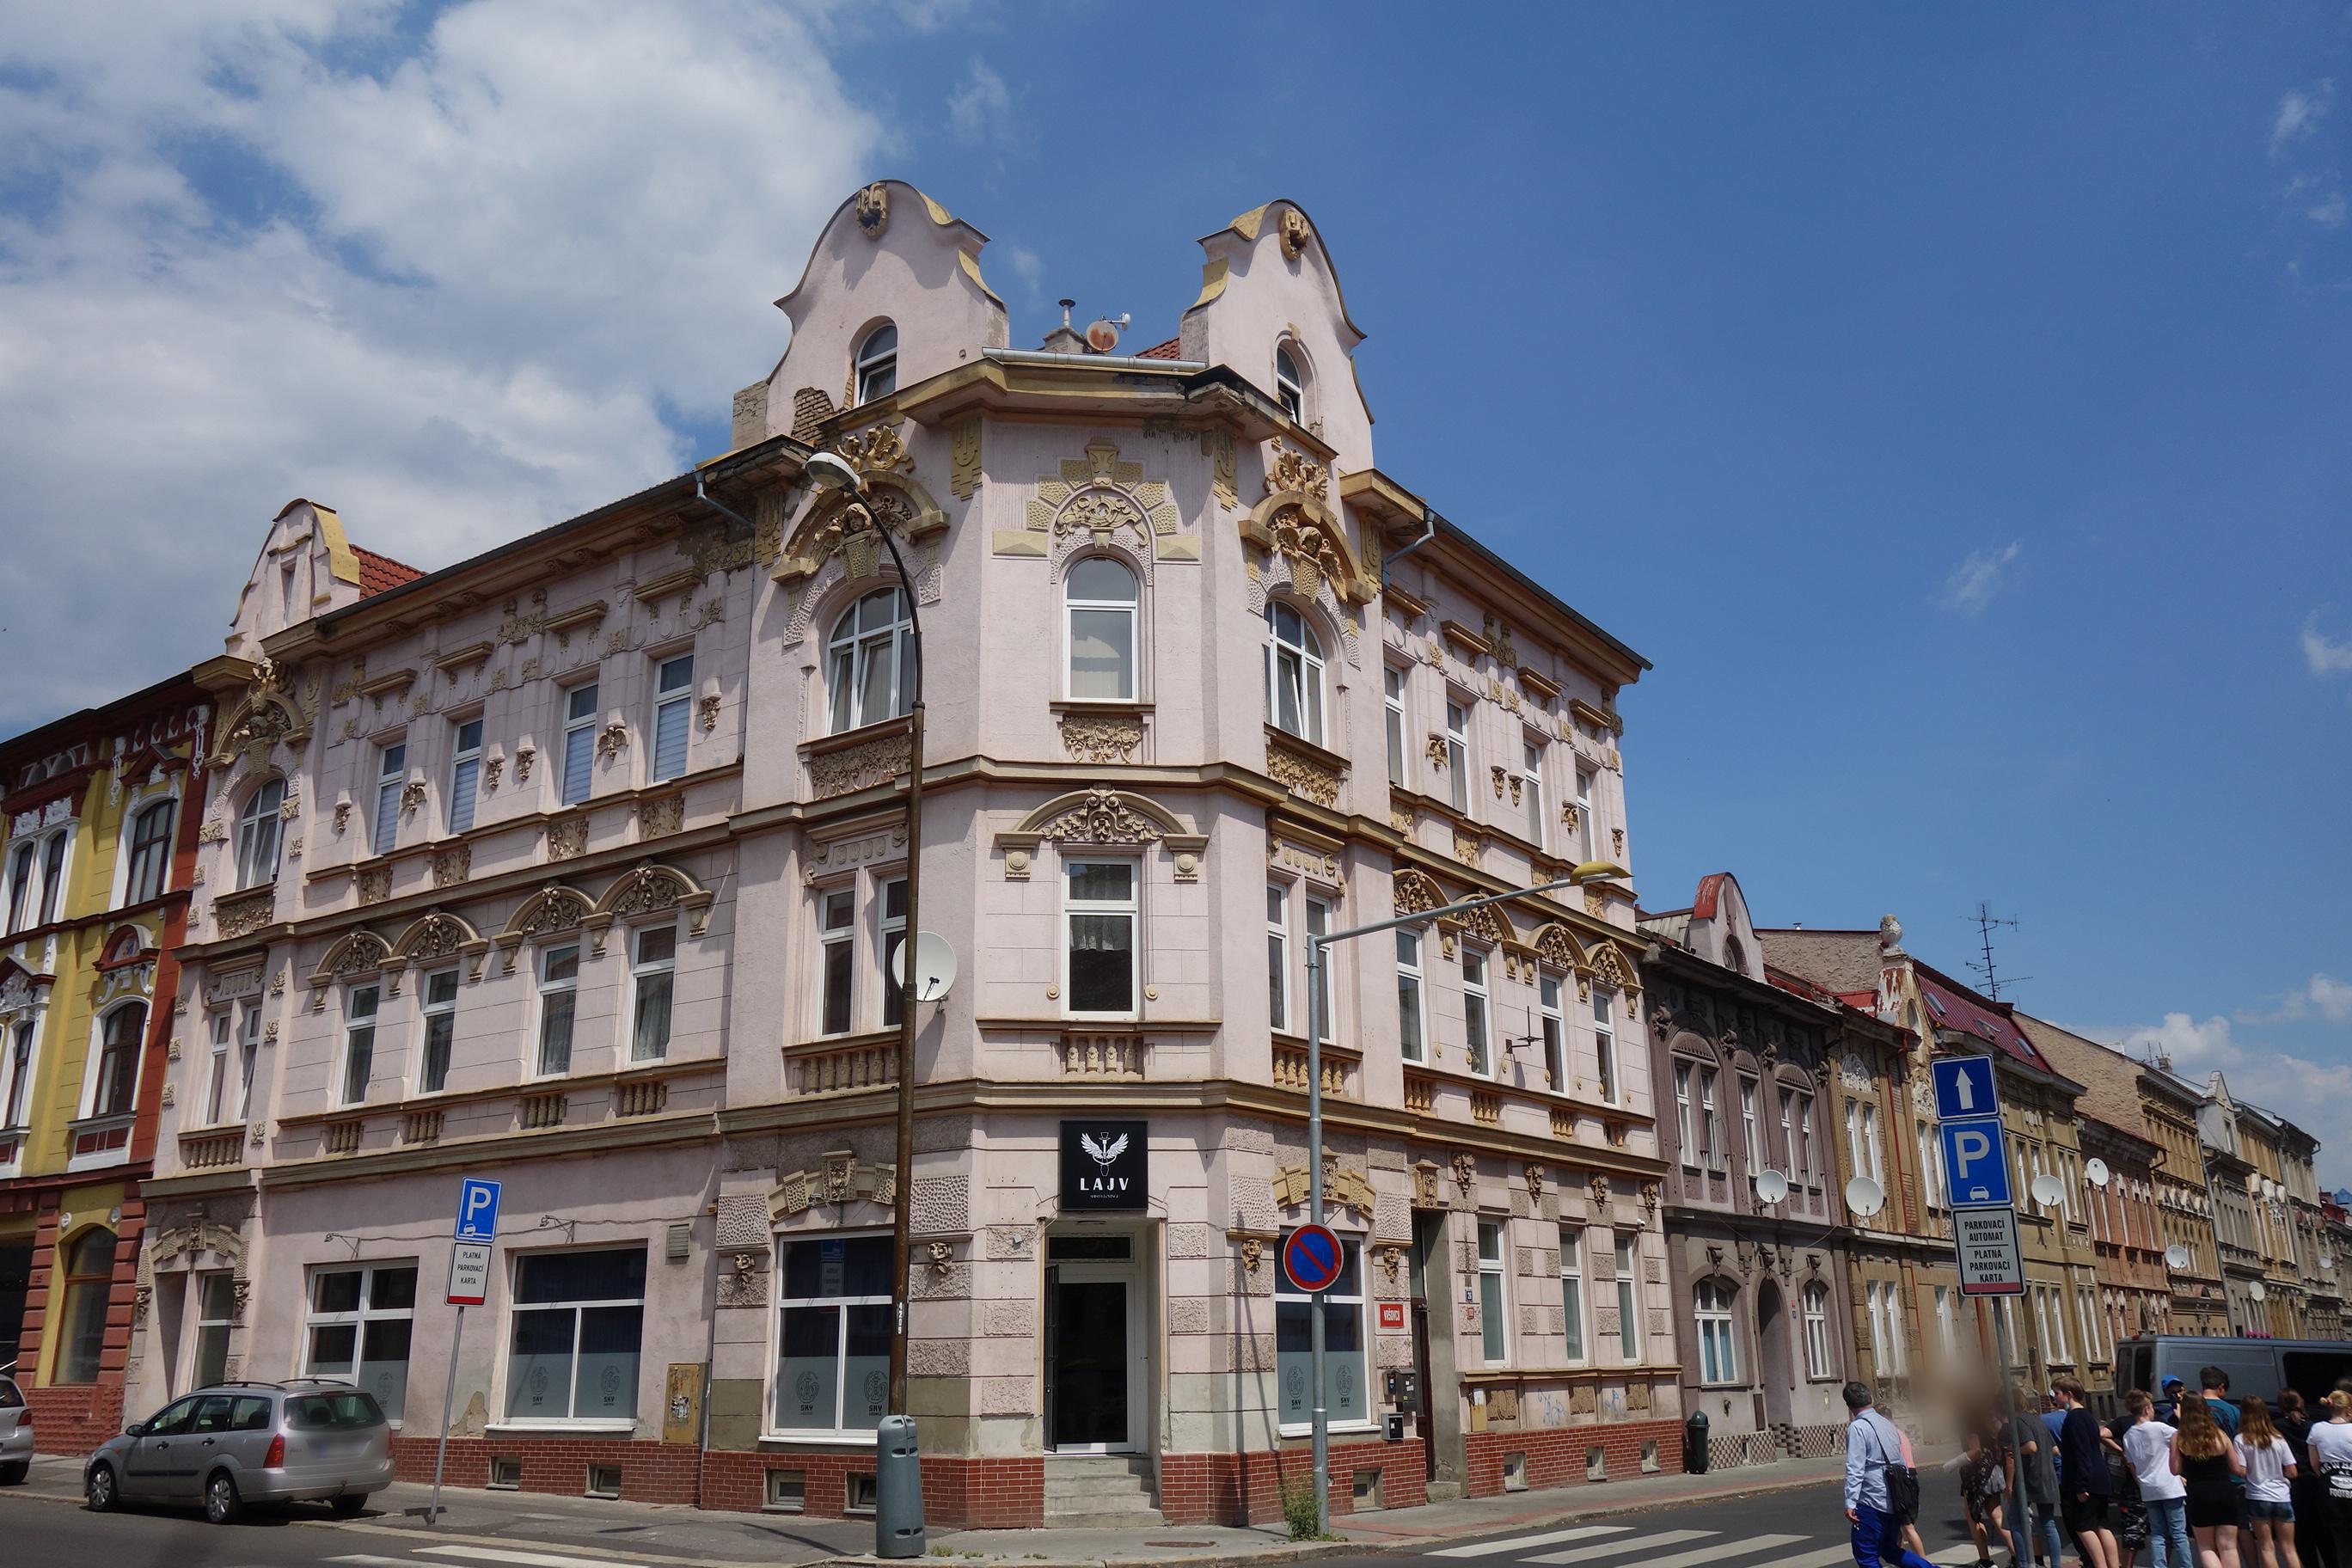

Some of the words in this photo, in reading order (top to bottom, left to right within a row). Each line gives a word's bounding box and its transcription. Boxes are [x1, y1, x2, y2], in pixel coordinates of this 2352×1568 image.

[1954, 1131, 1990, 1179] P
[1080, 1177, 1129, 1191] LAJV
[466, 1186, 492, 1221] P
[1964, 1217, 2006, 1230] PARKOVACÍ
[1969, 1232, 2003, 1241] AUTOMAT
[462, 1251, 481, 1259] PLATNÁ
[1974, 1247, 2003, 1259] PLATNÁ
[457, 1264, 484, 1272] PARKOVACÍ
[1969, 1259, 2011, 1271] PARKOVACÍ
[1979, 1273, 2004, 1283] KARTA
